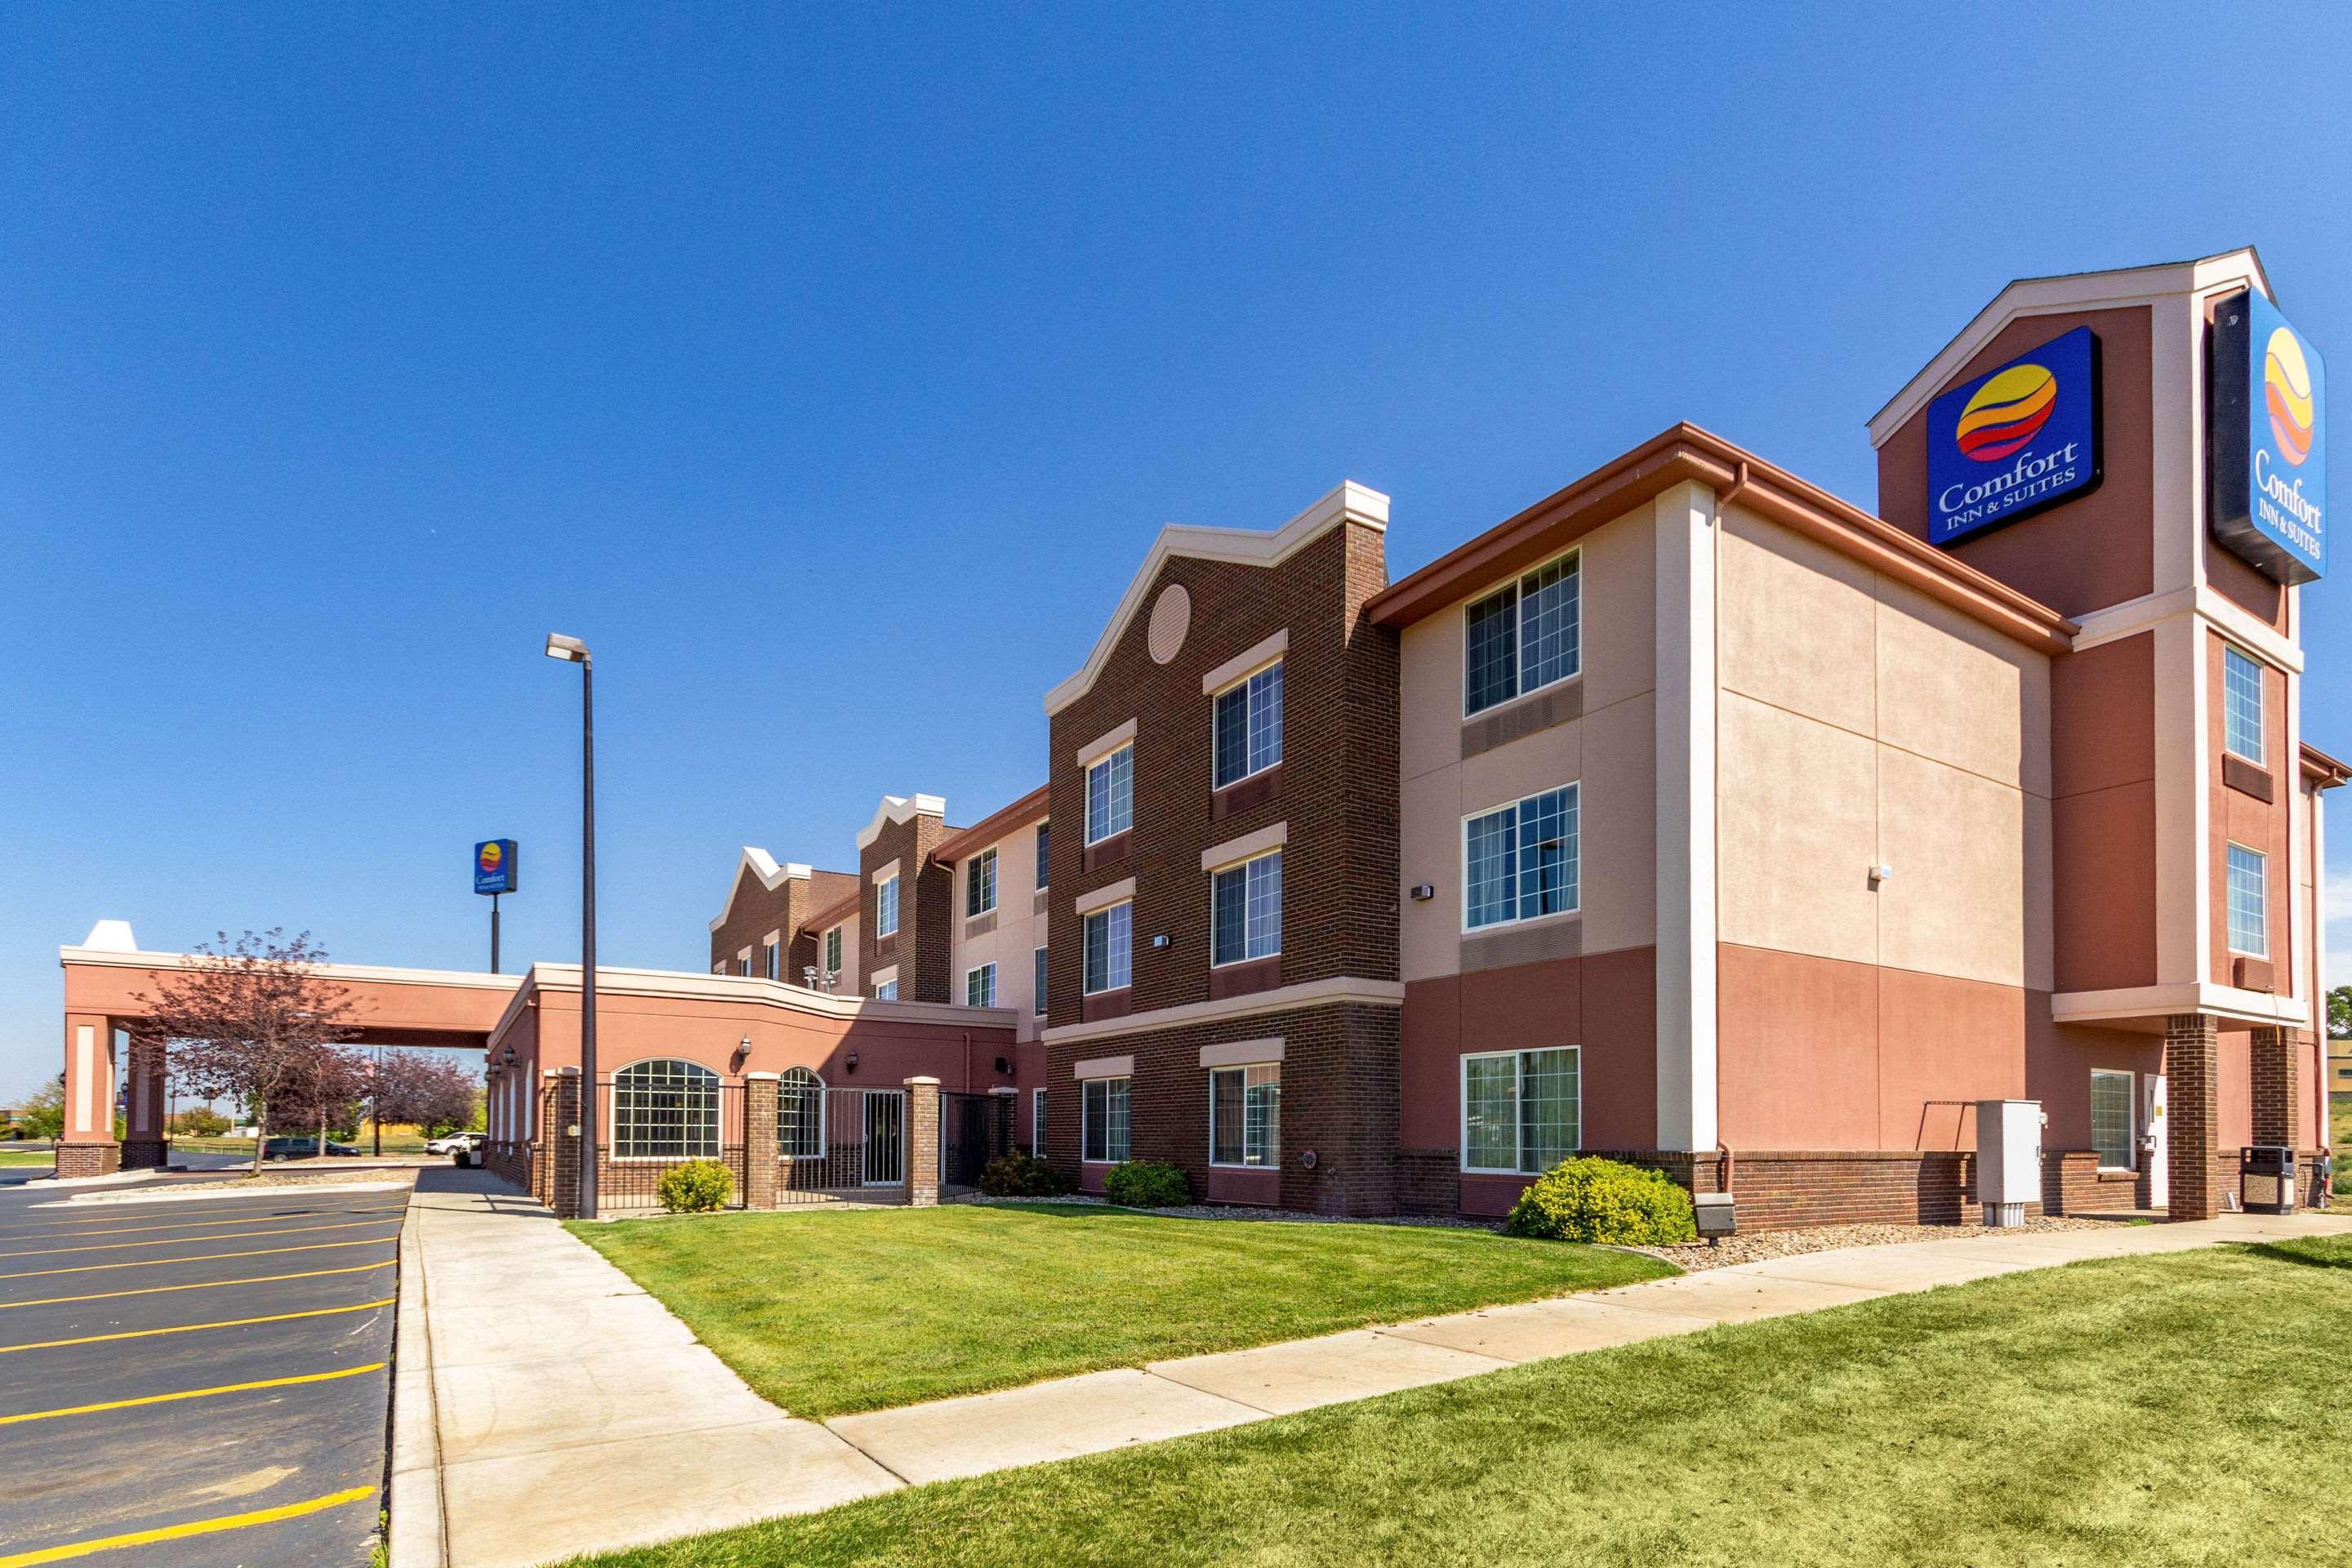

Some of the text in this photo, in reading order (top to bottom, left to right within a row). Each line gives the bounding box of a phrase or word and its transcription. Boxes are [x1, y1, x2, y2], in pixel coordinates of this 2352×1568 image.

[1939, 443, 2078, 513] Comfort
[1947, 467, 2076, 531] INN & SUITES
[2255, 449, 2322, 534] Comfort
[2259, 497, 2321, 560] INN & SUITES
